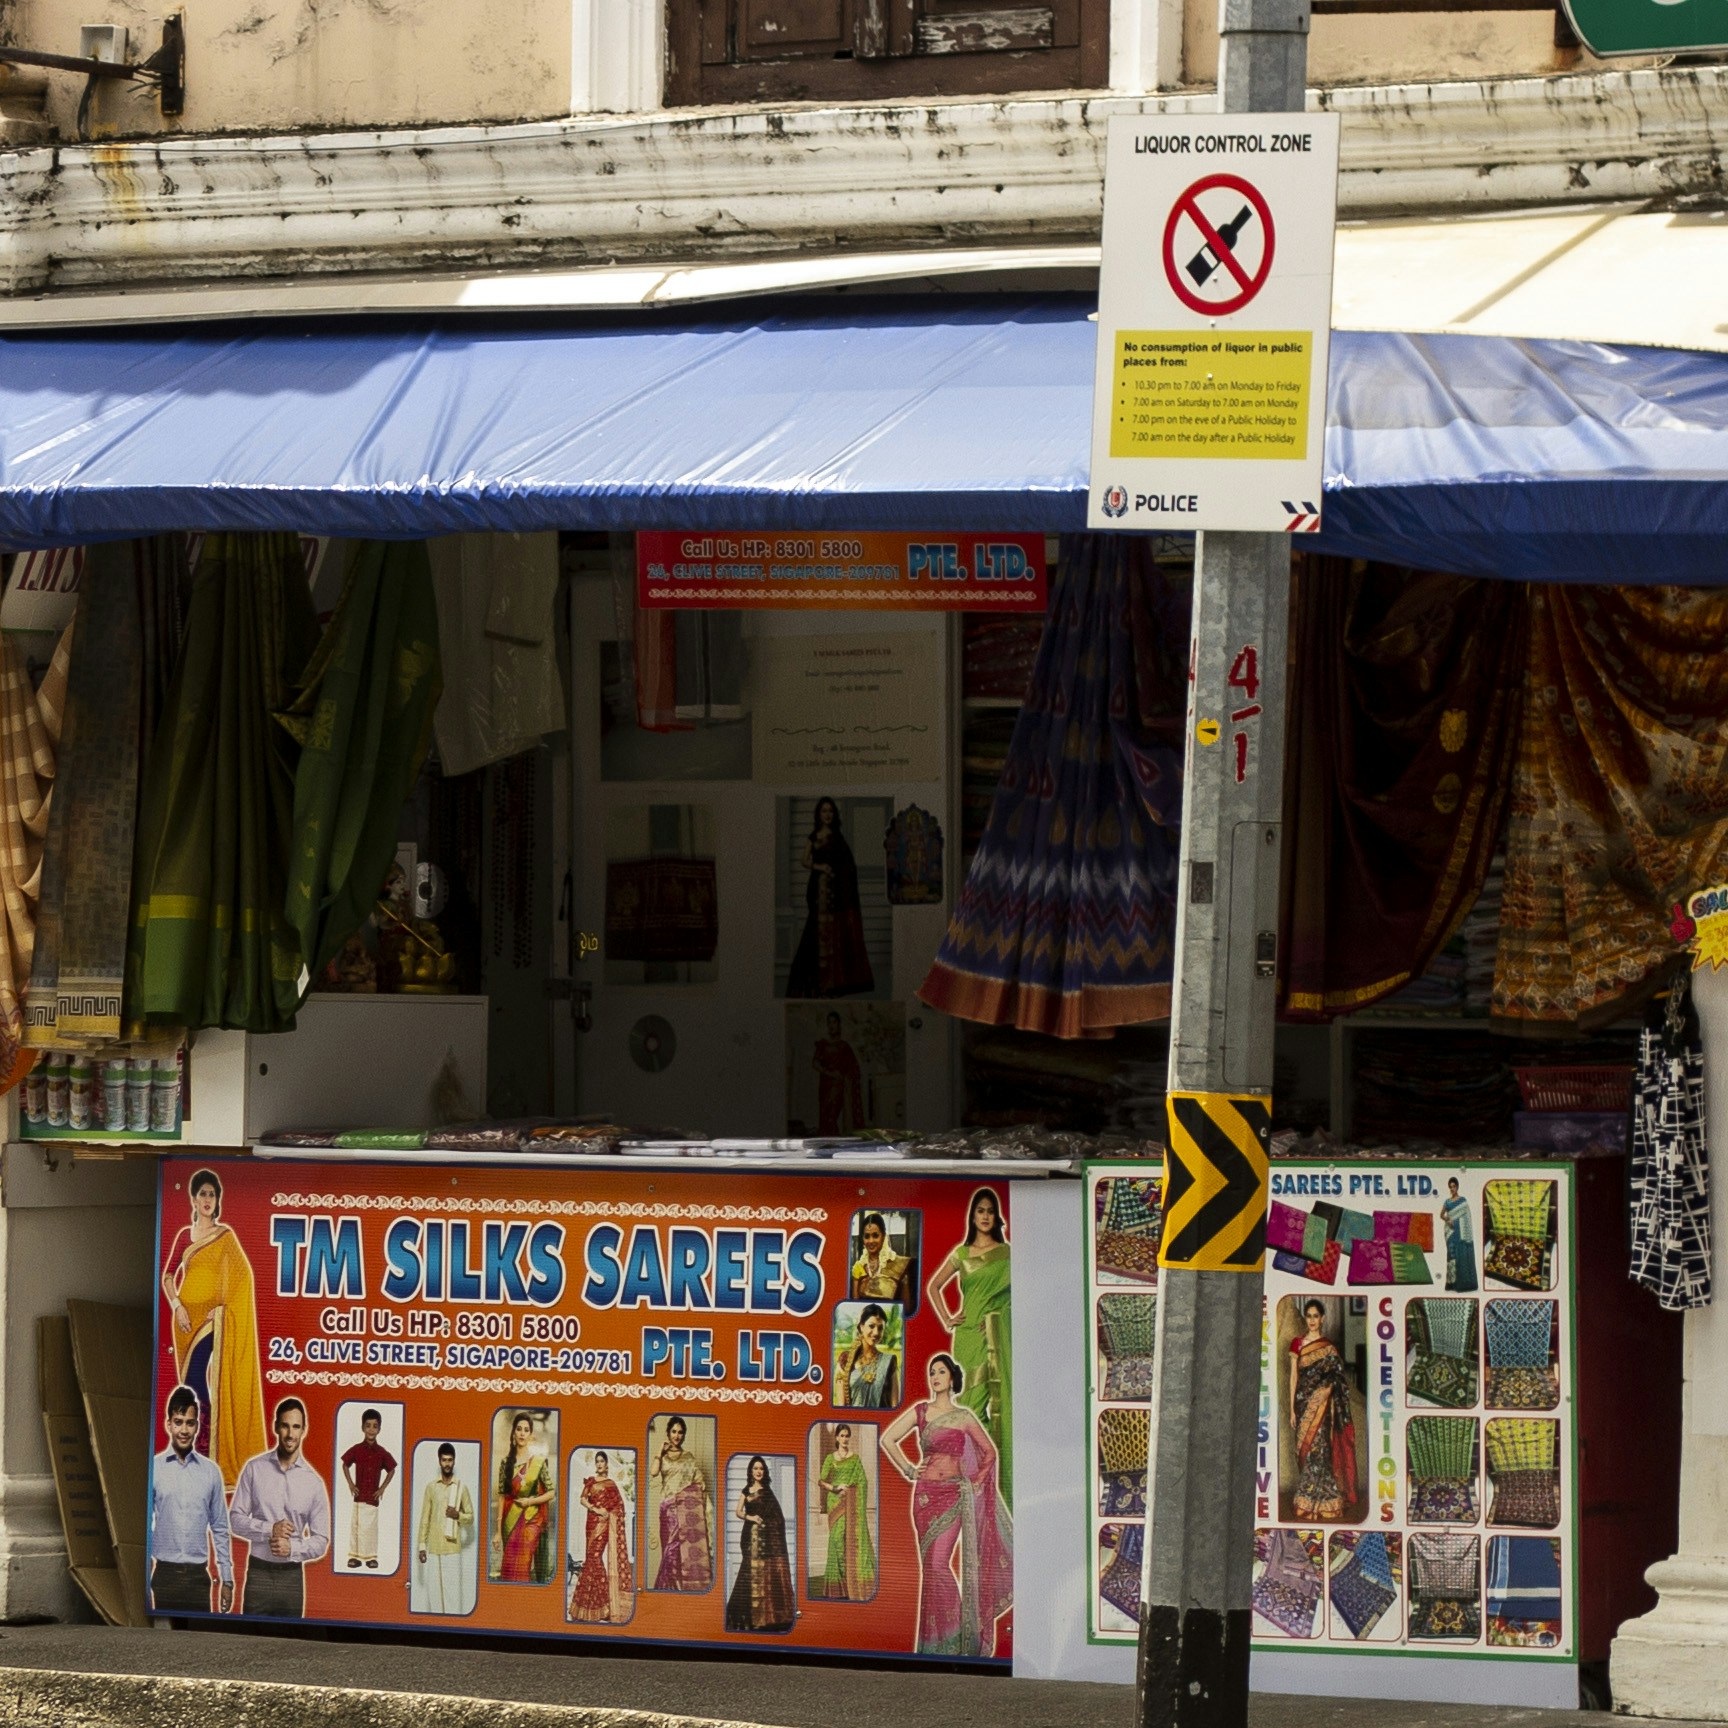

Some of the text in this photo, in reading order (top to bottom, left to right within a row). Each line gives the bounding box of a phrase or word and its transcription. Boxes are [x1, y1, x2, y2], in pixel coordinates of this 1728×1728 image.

[1135, 133, 1312, 155] LIQUOR CONTROL ZONE
[1124, 342, 1303, 355] No consumption of liquor in public
[1123, 357, 1188, 368] places from:
[1157, 383, 1171, 392] pm
[1173, 382, 1182, 391] to
[1183, 381, 1201, 391] 7.00
[1202, 383, 1216, 391] am
[1217, 383, 1228, 391] on
[1230, 381, 1263, 393] Monday
[1265, 382, 1274, 391] to
[1276, 381, 1301, 393] Friday
[1133, 397, 1299, 410] 7.00 am on Saturday to 7.00 am on Monday
[1132, 414, 1149, 424] 7.00
[1150, 417, 1165, 426] pm
[1166, 417, 1177, 425] on
[1179, 415, 1193, 425] the
[1194, 417, 1209, 425] eve
[1211, 415, 1220, 425] of
[1228, 415, 1252, 425] Public
[1255, 416, 1286, 427] Holiday
[1287, 417, 1297, 425] to
[1131, 432, 1149, 442] 7.00
[1150, 434, 1163, 442] am
[1164, 434, 1176, 443] on
[1177, 433, 1191, 443] the
[1193, 433, 1207, 445] day
[1209, 433, 1229, 443] after
[1237, 433, 1261, 443] Public
[1264, 434, 1296, 445] Holiday
[1135, 494, 1199, 513] POLICE
[681, 539, 863, 559] Call Us HP: 8301 5800
[907, 543, 1035, 582] PTE. LTD.
[673, 564, 712, 580] CLIVE
[715, 564, 765, 582] STREET,
[1271, 1174, 1438, 1196] SAREES PTE. LTD.
[270, 1213, 826, 1317] TM SILKS SAREES
[320, 1307, 581, 1342] Call Us HP: 8301 5800
[269, 1337, 633, 1373] 26, CLIVE STREET, SIGAPORE-209781
[642, 1326, 824, 1385] PTE. LTD.
